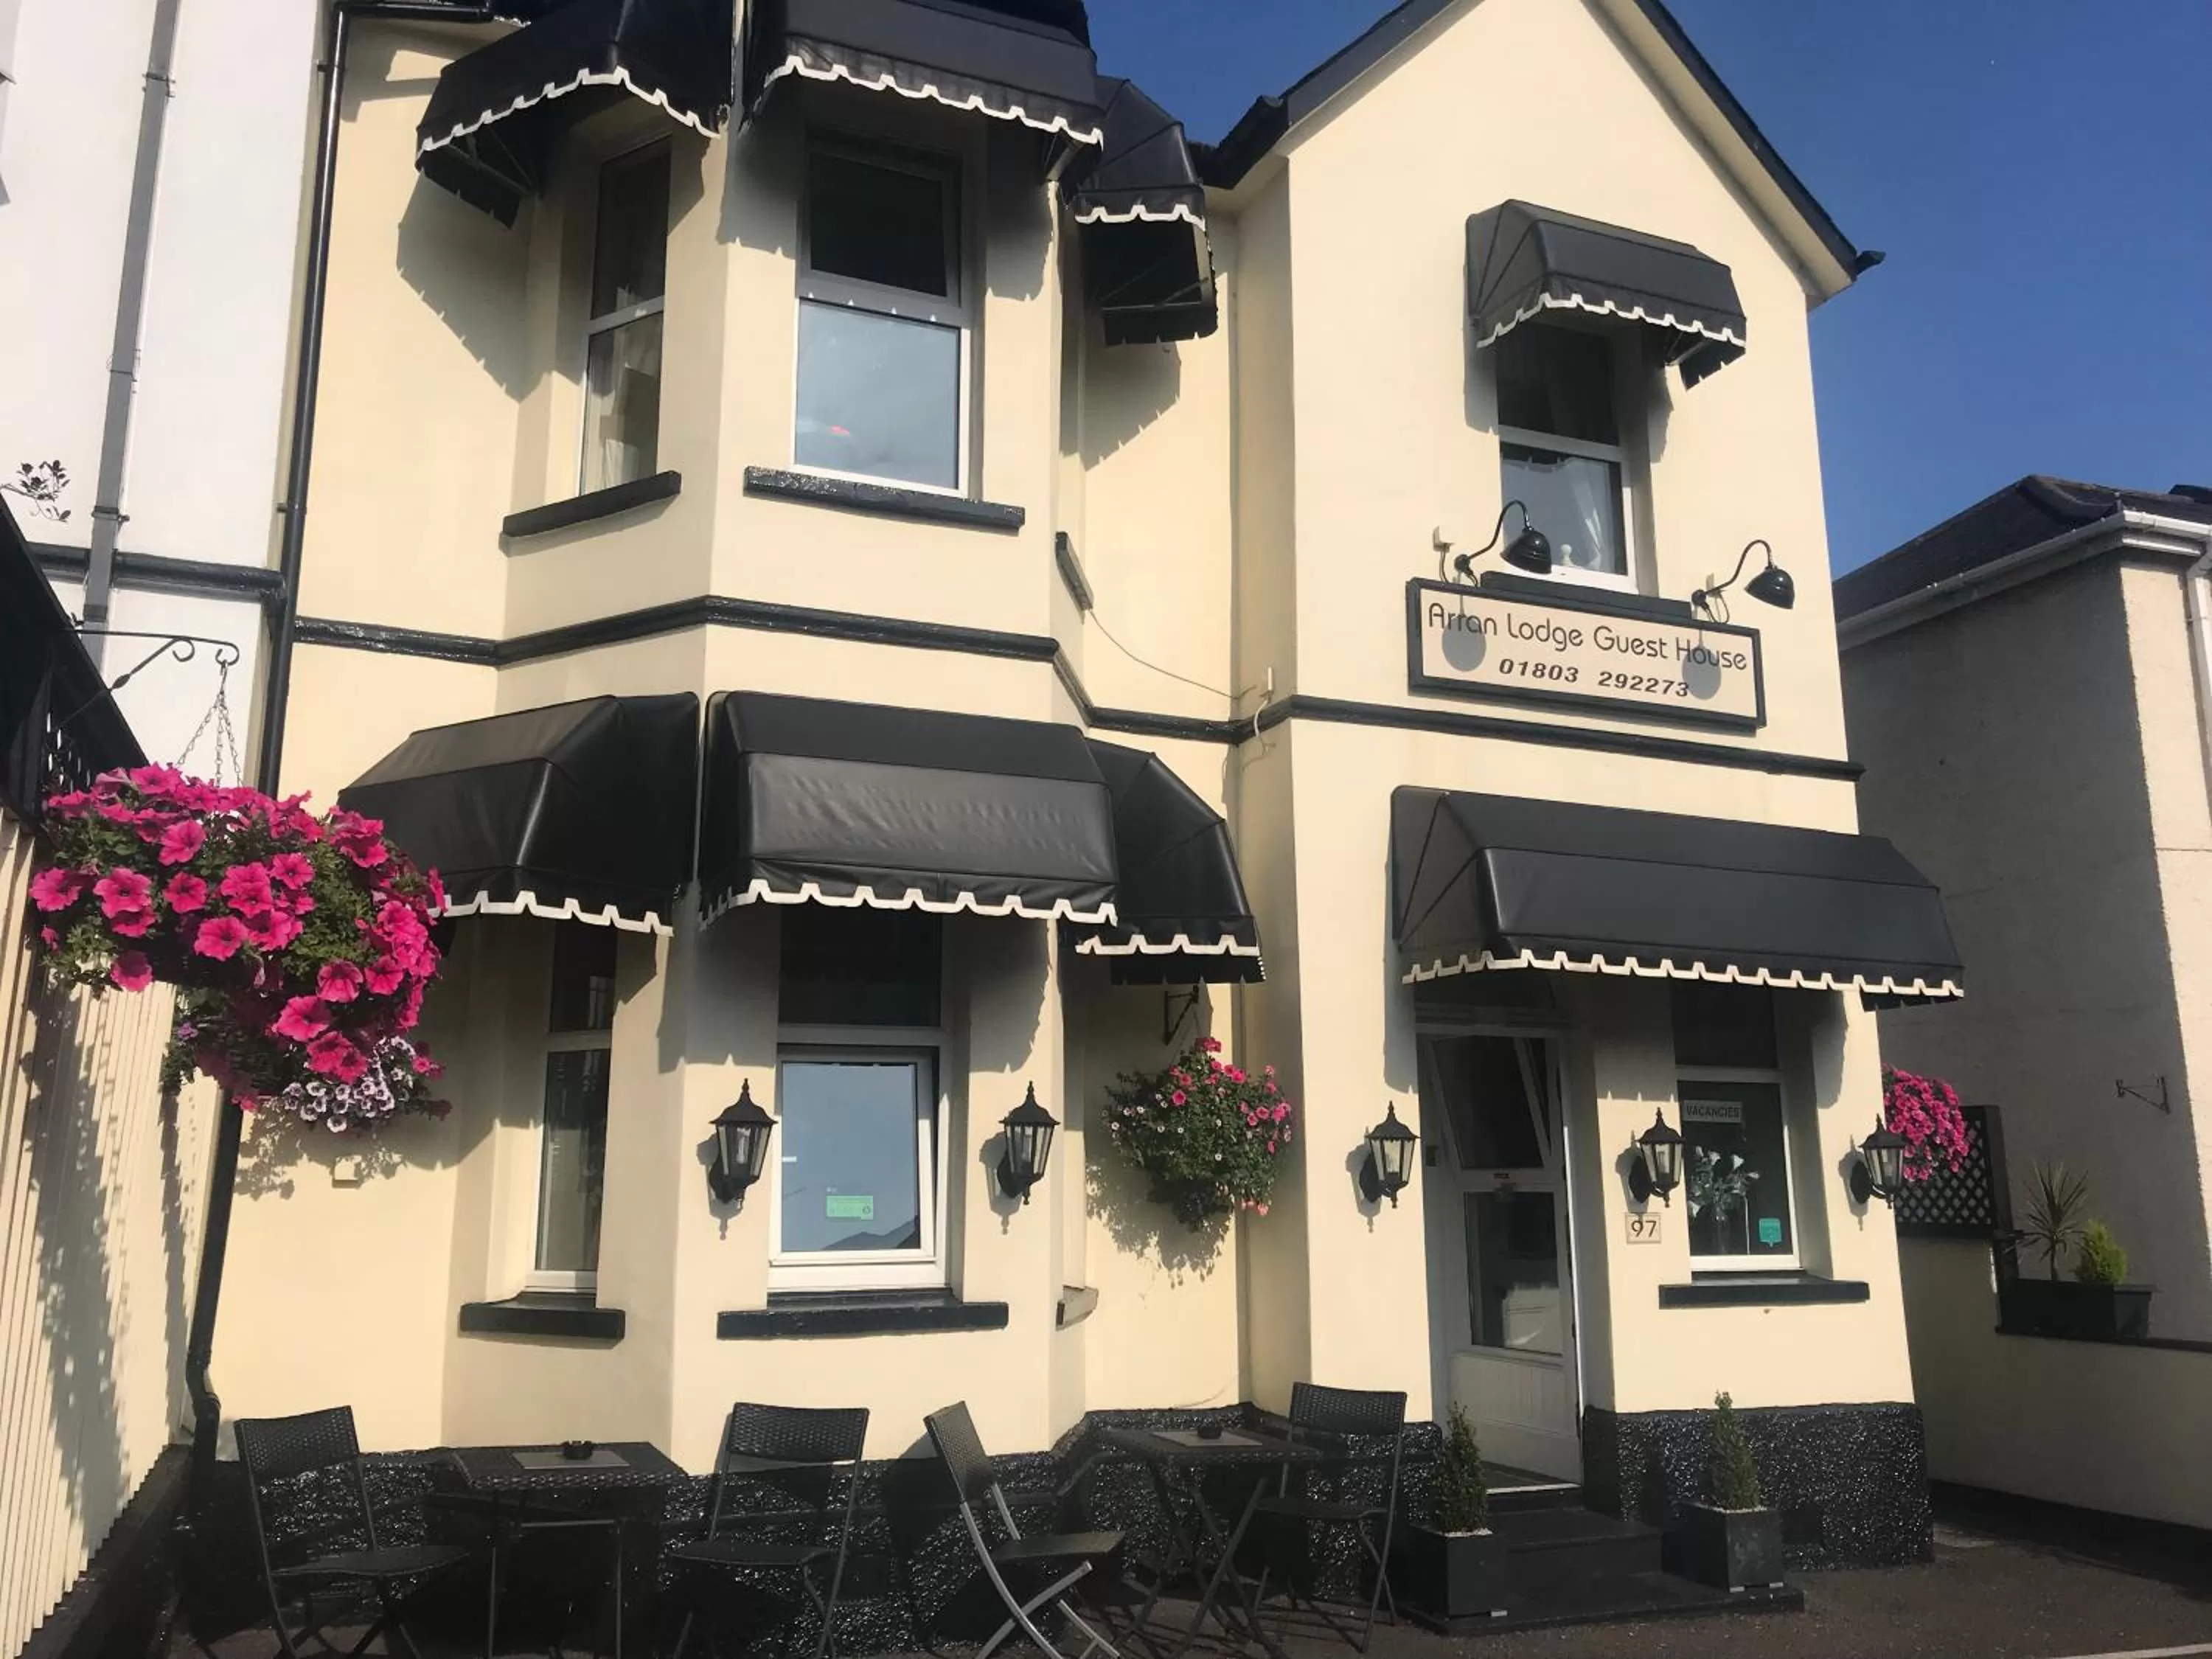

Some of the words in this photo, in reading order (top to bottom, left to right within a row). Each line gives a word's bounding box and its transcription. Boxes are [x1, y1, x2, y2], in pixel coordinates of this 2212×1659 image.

[1428, 602, 1498, 636] Arran
[1507, 613, 1584, 652] Lodge
[1593, 625, 1669, 659] Guest
[1675, 636, 1747, 670] House
[1499, 658, 1579, 683] 01803
[1598, 671, 1690, 698] 292273
[1686, 1105, 1740, 1119] VACANCIES
[1631, 1220, 1657, 1237] 97
